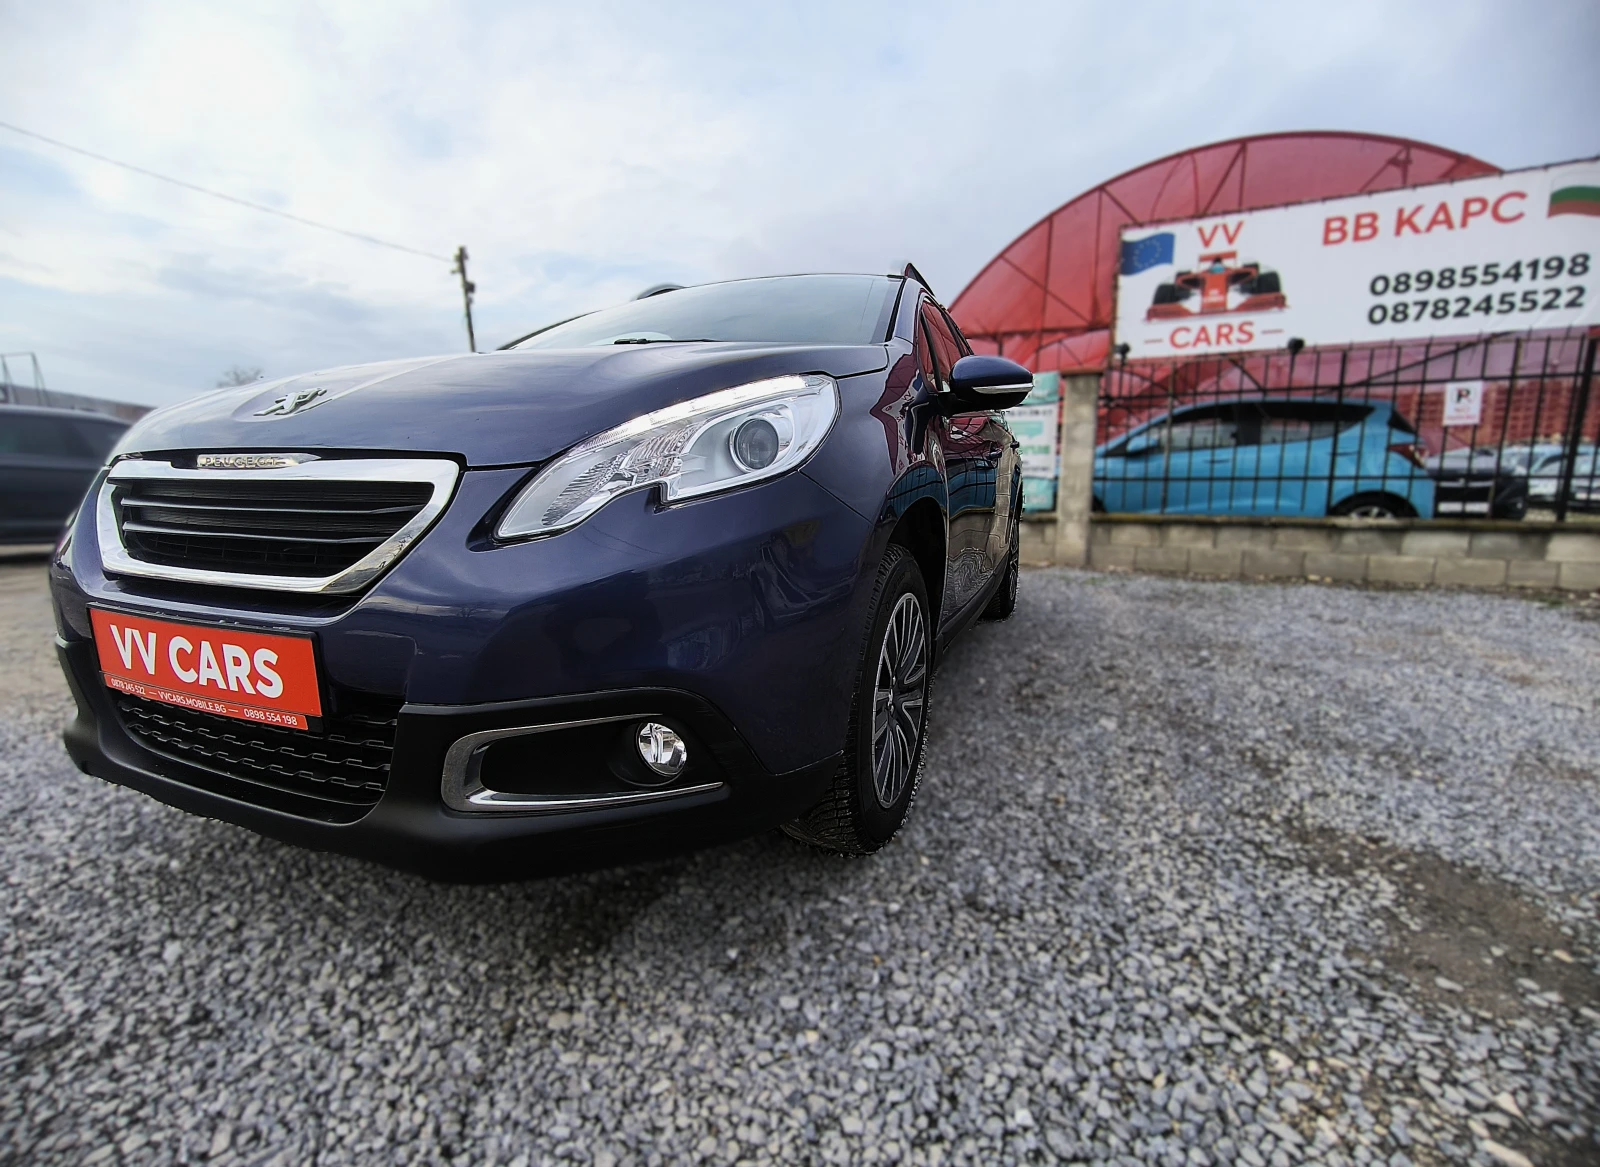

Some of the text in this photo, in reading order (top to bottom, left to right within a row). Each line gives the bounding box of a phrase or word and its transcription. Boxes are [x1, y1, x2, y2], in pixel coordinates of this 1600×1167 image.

[1197, 220, 1244, 248] VV
[1322, 190, 1527, 246] ВВ КАРС
[1369, 253, 1591, 296] 0898554198
[1367, 285, 1586, 325] 0878245522
[1169, 320, 1254, 349] CARS
[110, 624, 284, 698] VV CARS
[111, 678, 125, 690] 0878
[134, 685, 146, 695] 522
[157, 690, 227, 713] VVCARS.MOBILE.BG
[243, 708, 265, 720] 0898
[265, 712, 281, 723] 554
[282, 715, 298, 726] 198
